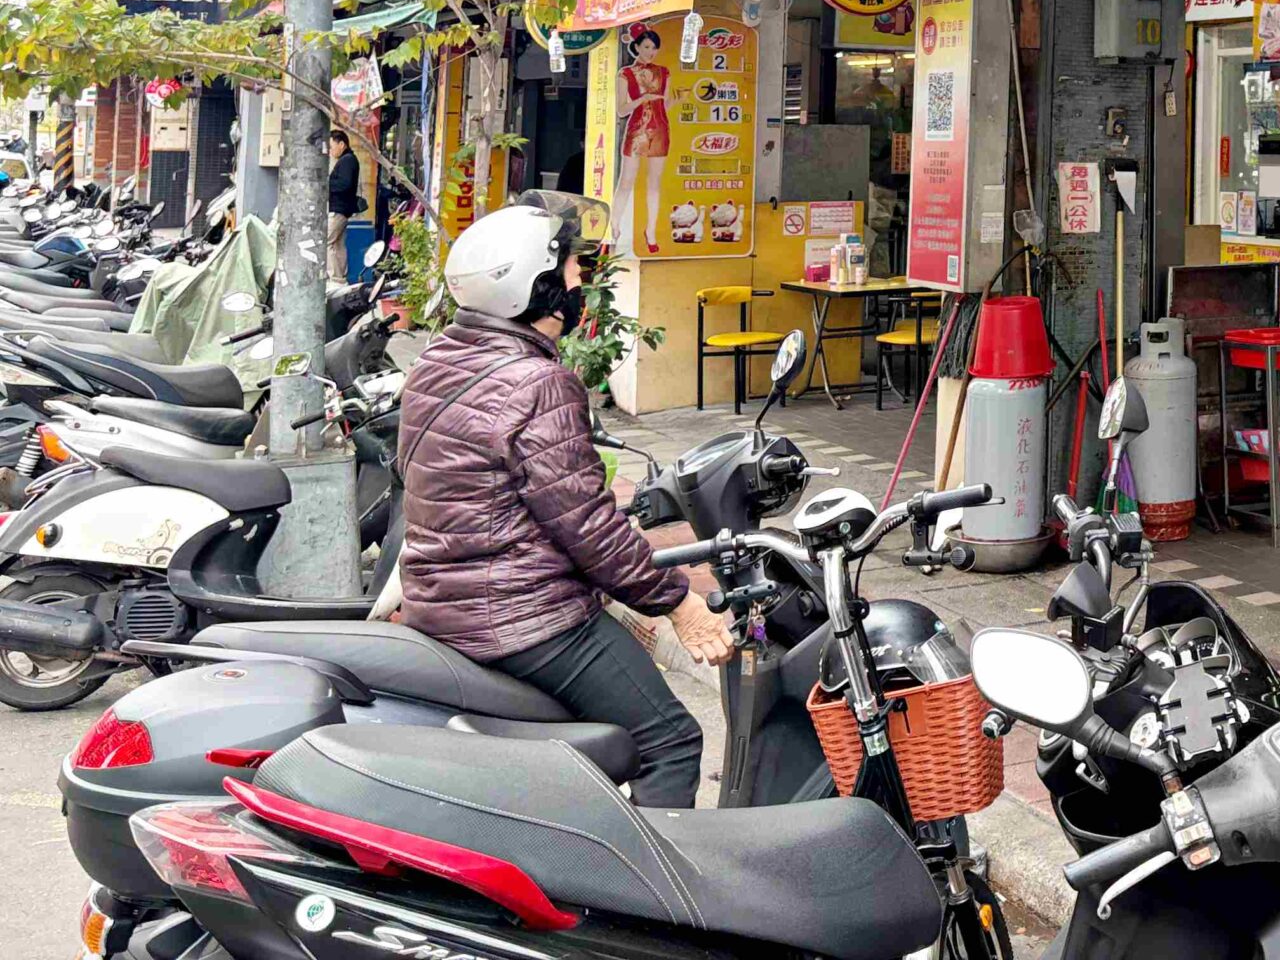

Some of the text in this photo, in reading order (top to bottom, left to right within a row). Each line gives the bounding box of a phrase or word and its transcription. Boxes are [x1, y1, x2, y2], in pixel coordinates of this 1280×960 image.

[1137, 18, 1161, 44] 10
[712, 106, 739, 123] 1.6
[697, 135, 736, 150] 大福彩
